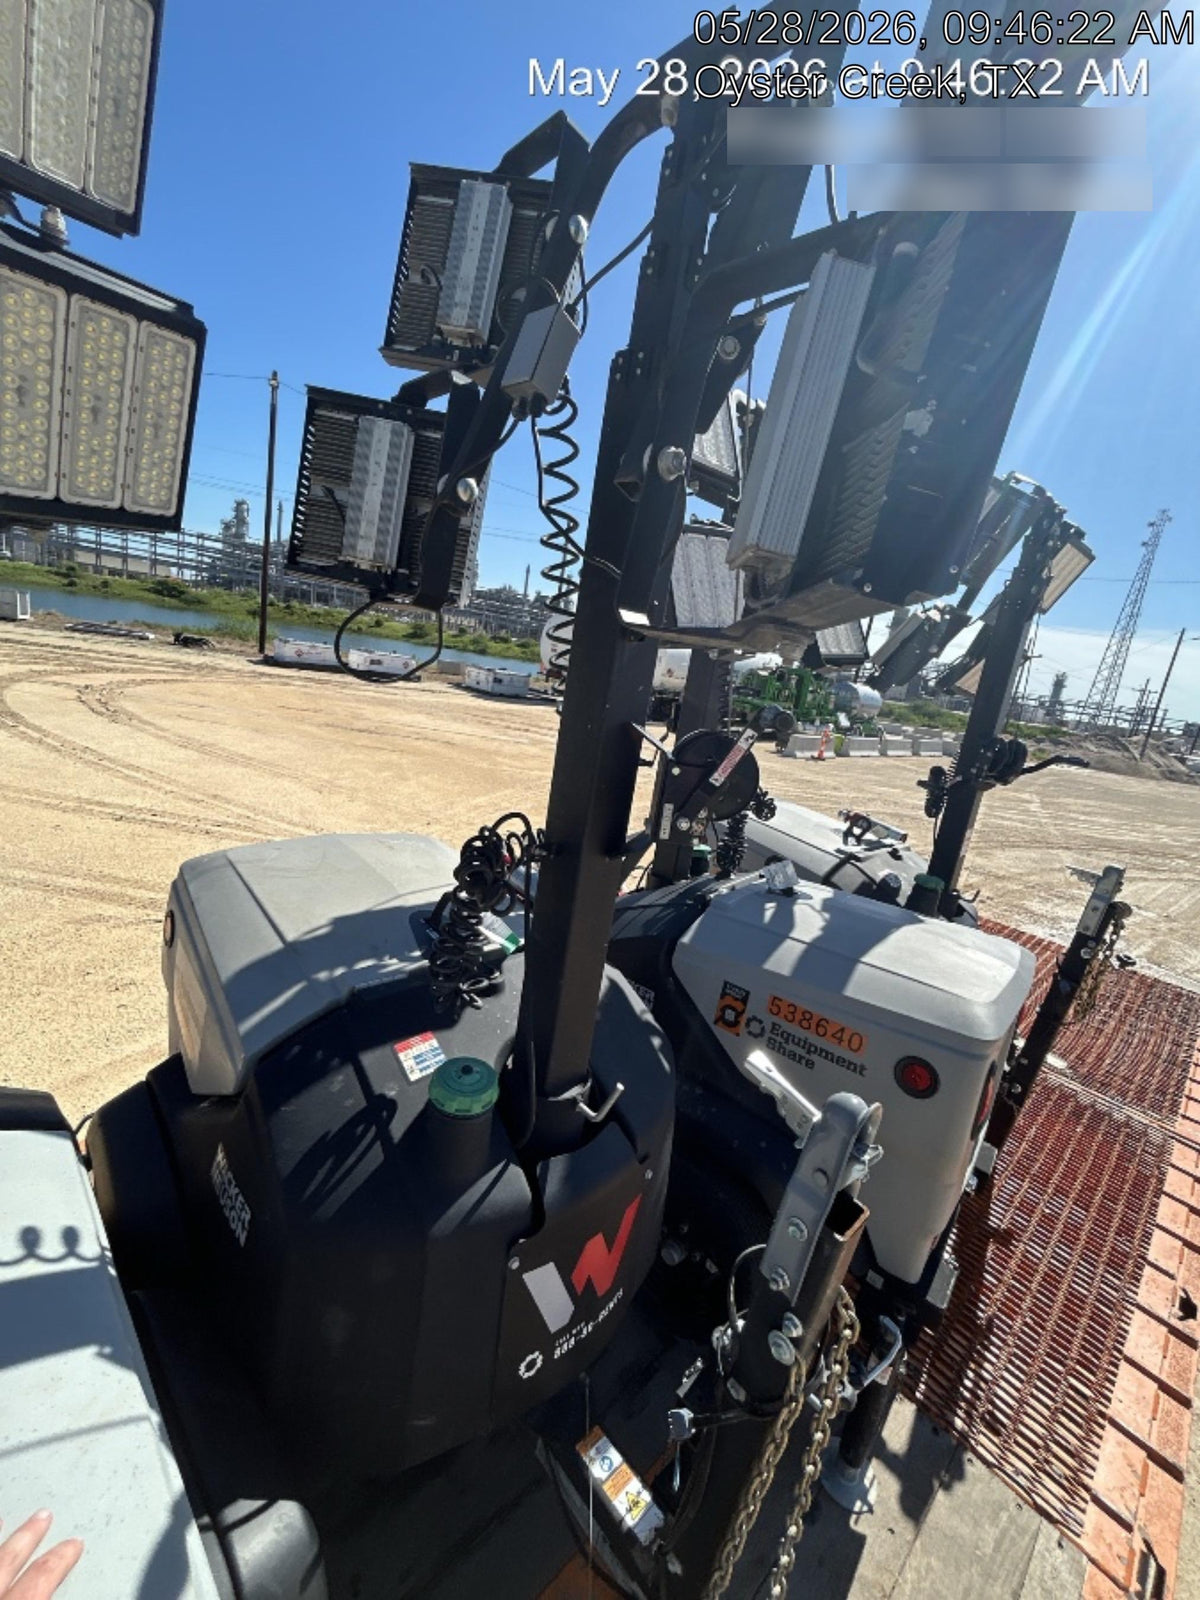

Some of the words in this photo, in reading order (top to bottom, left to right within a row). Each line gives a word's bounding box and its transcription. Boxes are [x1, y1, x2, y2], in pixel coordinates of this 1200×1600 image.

[766, 1035, 816, 1070] Share
[768, 996, 864, 1053] 538640
[768, 1021, 868, 1078] Equipment
